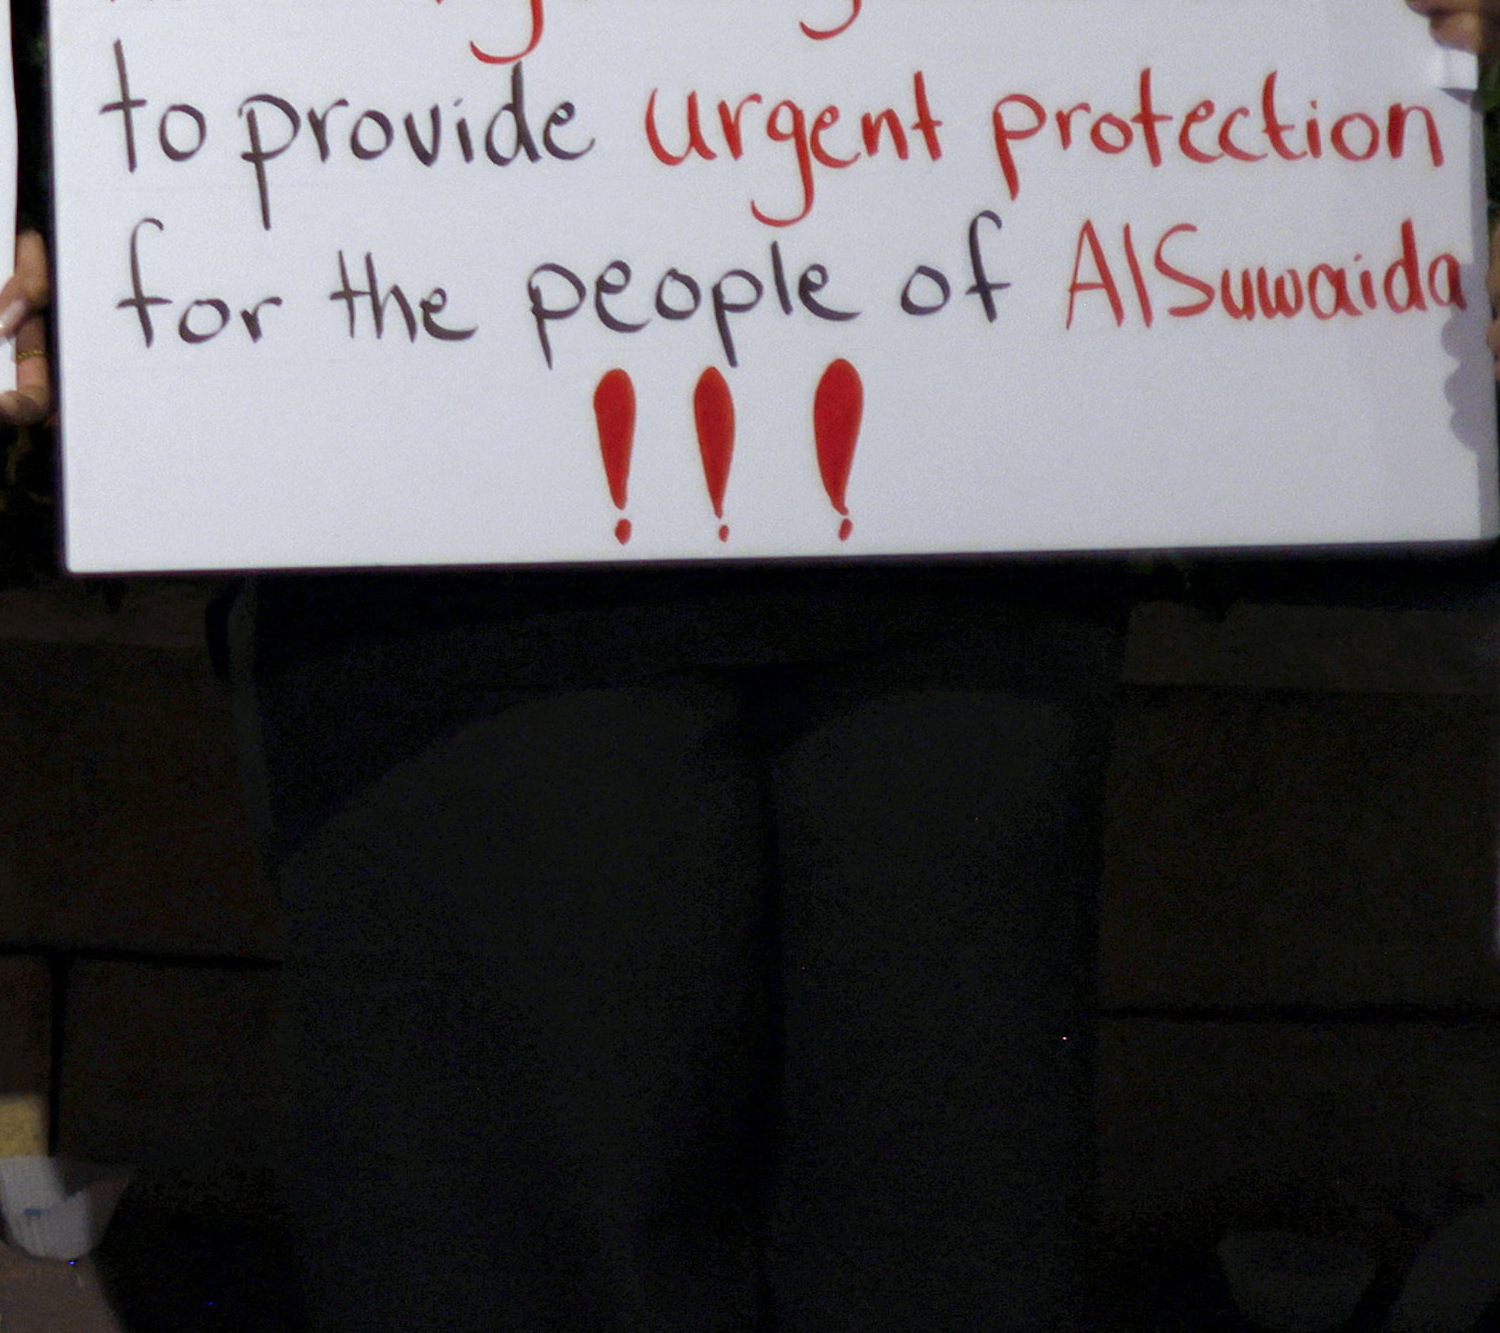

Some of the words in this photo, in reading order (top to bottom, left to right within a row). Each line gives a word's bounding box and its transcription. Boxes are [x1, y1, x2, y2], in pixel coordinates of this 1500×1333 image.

[99, 38, 208, 174] to
[237, 63, 596, 230] provide
[643, 70, 943, 229] urgent
[991, 67, 1445, 202] protection
[115, 217, 284, 349] for
[328, 249, 477, 344] the
[526, 240, 862, 370] people
[899, 209, 1012, 324] of
[1065, 218, 1468, 331] AlSuwaida
